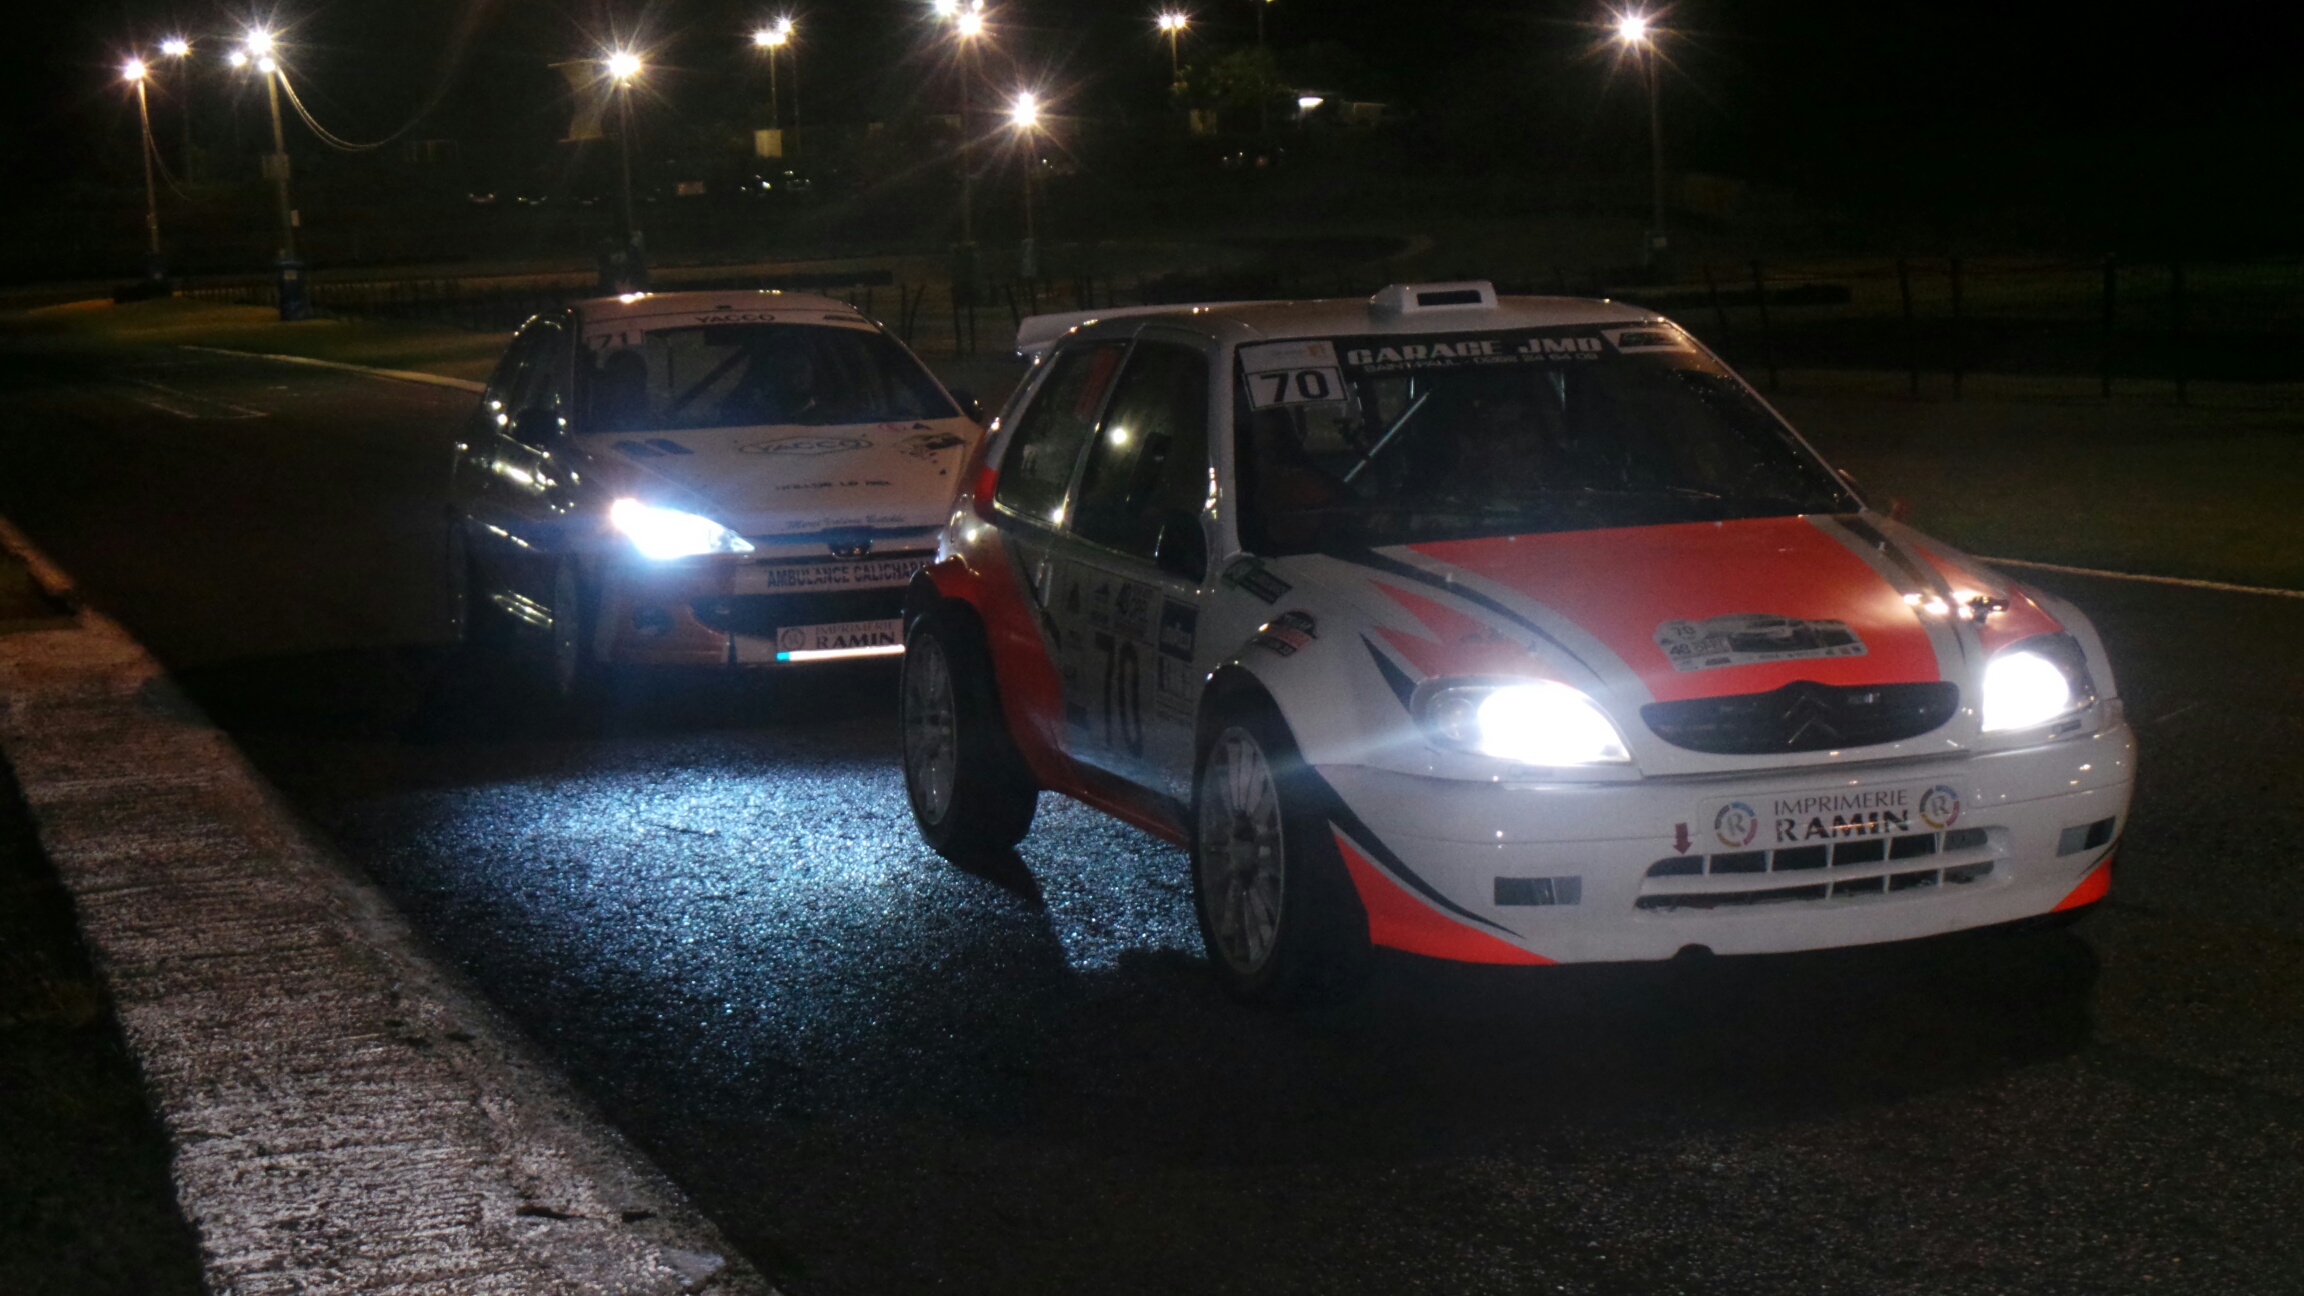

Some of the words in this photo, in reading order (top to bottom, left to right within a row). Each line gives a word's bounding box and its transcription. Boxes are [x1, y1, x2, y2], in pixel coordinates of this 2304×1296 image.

[695, 314, 775, 323] YACCO
[1347, 340, 1503, 365] GARAGE
[1518, 337, 1603, 354] JMD
[1260, 370, 1330, 403] 70
[768, 566, 849, 588] AMBULANCE
[816, 621, 892, 635] IMPRIMERIE
[816, 632, 895, 649] RAMIN
[1095, 631, 1144, 757] 70
[1774, 789, 1907, 816] IMPRIMERIE
[1776, 809, 1908, 843] RAMIN
